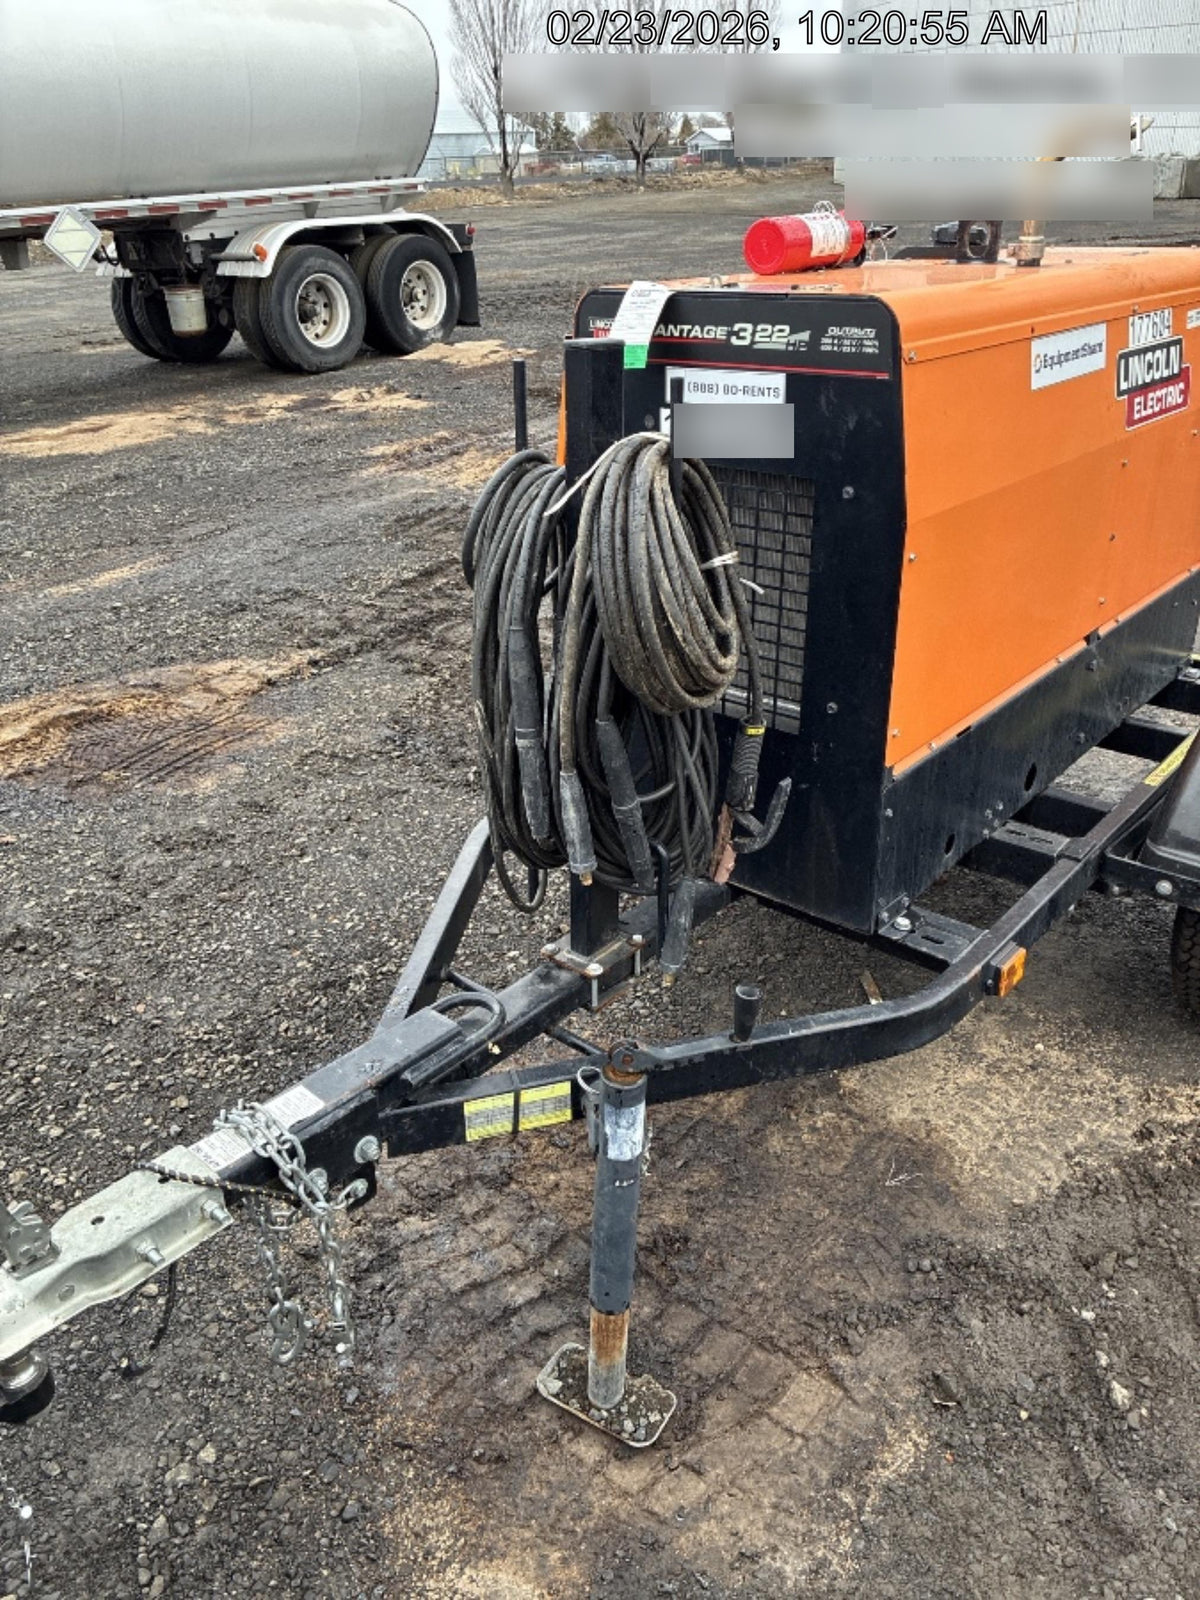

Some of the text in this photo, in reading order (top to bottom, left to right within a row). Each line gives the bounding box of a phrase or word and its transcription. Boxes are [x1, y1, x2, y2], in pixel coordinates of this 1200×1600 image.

[653, 323, 729, 340] ANTAGE
[729, 322, 791, 347] 322
[1119, 344, 1181, 392] LINCOLN
[1133, 381, 1186, 420] ELECTRIC
